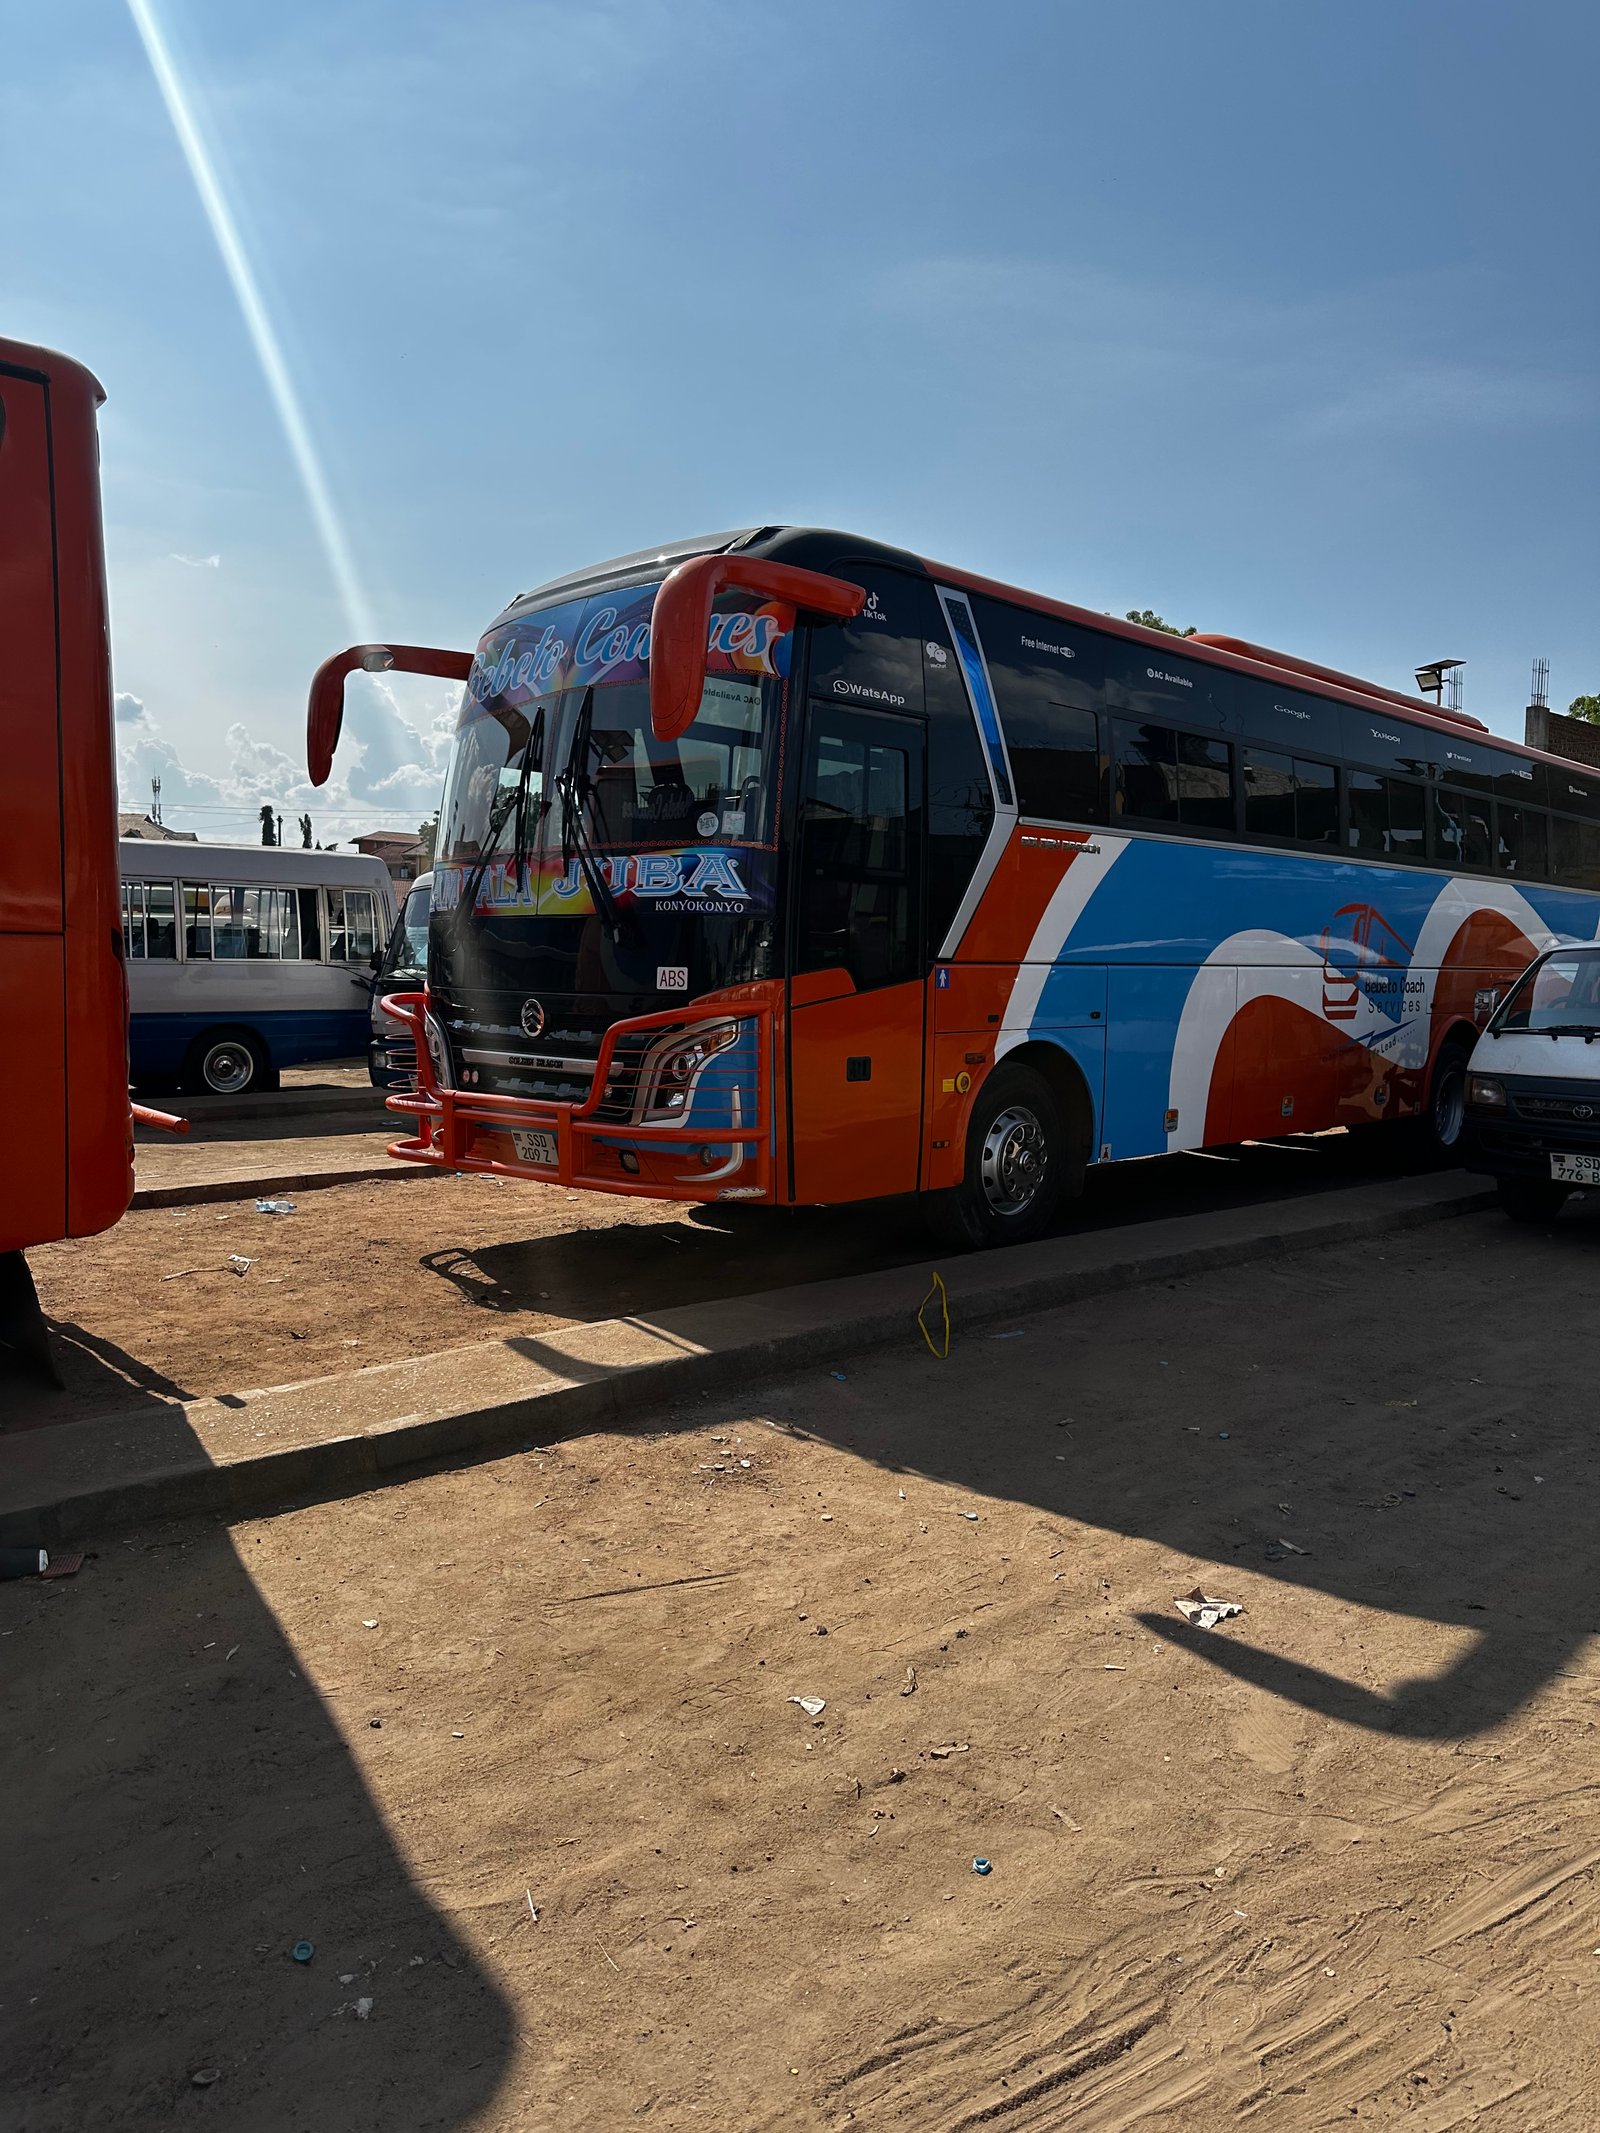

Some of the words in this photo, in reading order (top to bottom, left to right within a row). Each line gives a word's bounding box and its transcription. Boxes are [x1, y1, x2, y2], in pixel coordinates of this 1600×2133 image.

[863, 609, 887, 621] TikTok
[574, 607, 785, 667] Coaes
[1021, 635, 1035, 648] Free
[1036, 639, 1060, 655] Internet
[1154, 670, 1164, 680] AC
[1165, 673, 1193, 688] Available
[849, 683, 905, 706] WatsApp
[1274, 704, 1311, 720] Google
[430, 863, 533, 913] AMALA
[552, 853, 752, 900] JUBA
[655, 899, 744, 913] KONYOKONYO
[660, 969, 686, 987] ABS
[1365, 975, 1397, 994] Bebeto
[1400, 975, 1425, 994] Coach
[1368, 998, 1421, 1013] Services
[526, 1133, 547, 1148] SSD
[521, 1146, 541, 1161] 209
[543, 1149, 552, 1163] Z
[1575, 1156, 1600, 1170] SSD
[1558, 1167, 1584, 1181] 776
